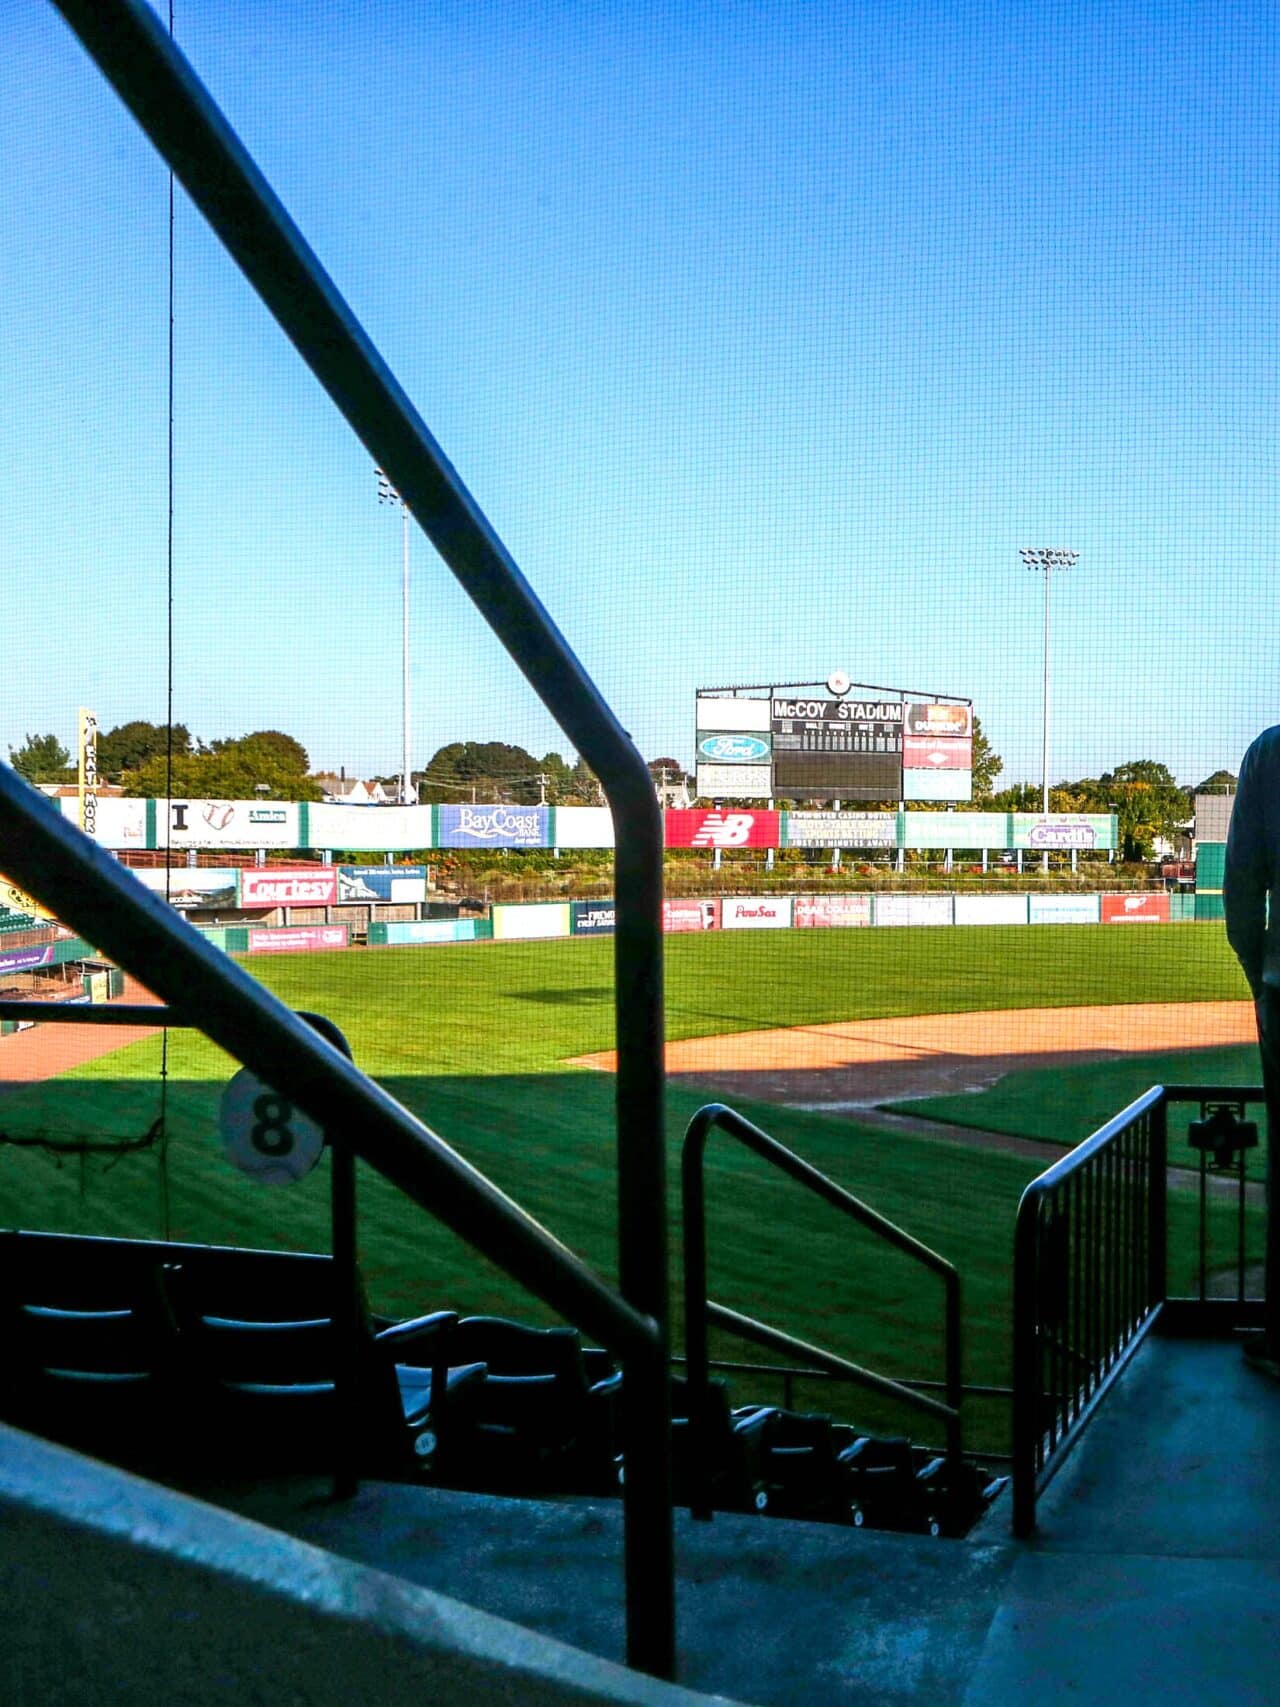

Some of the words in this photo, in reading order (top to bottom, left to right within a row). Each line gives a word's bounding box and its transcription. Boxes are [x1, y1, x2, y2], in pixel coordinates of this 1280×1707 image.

[774, 702, 828, 718] McCOY
[837, 703, 901, 720] STADIUM
[84, 743, 97, 786] EAT
[84, 792, 98, 834] MOR
[172, 804, 189, 831] I
[460, 807, 541, 832] BayCoast
[243, 876, 335, 902] Courtesy
[735, 906, 777, 918] PawSox
[252, 1093, 294, 1157] 8
